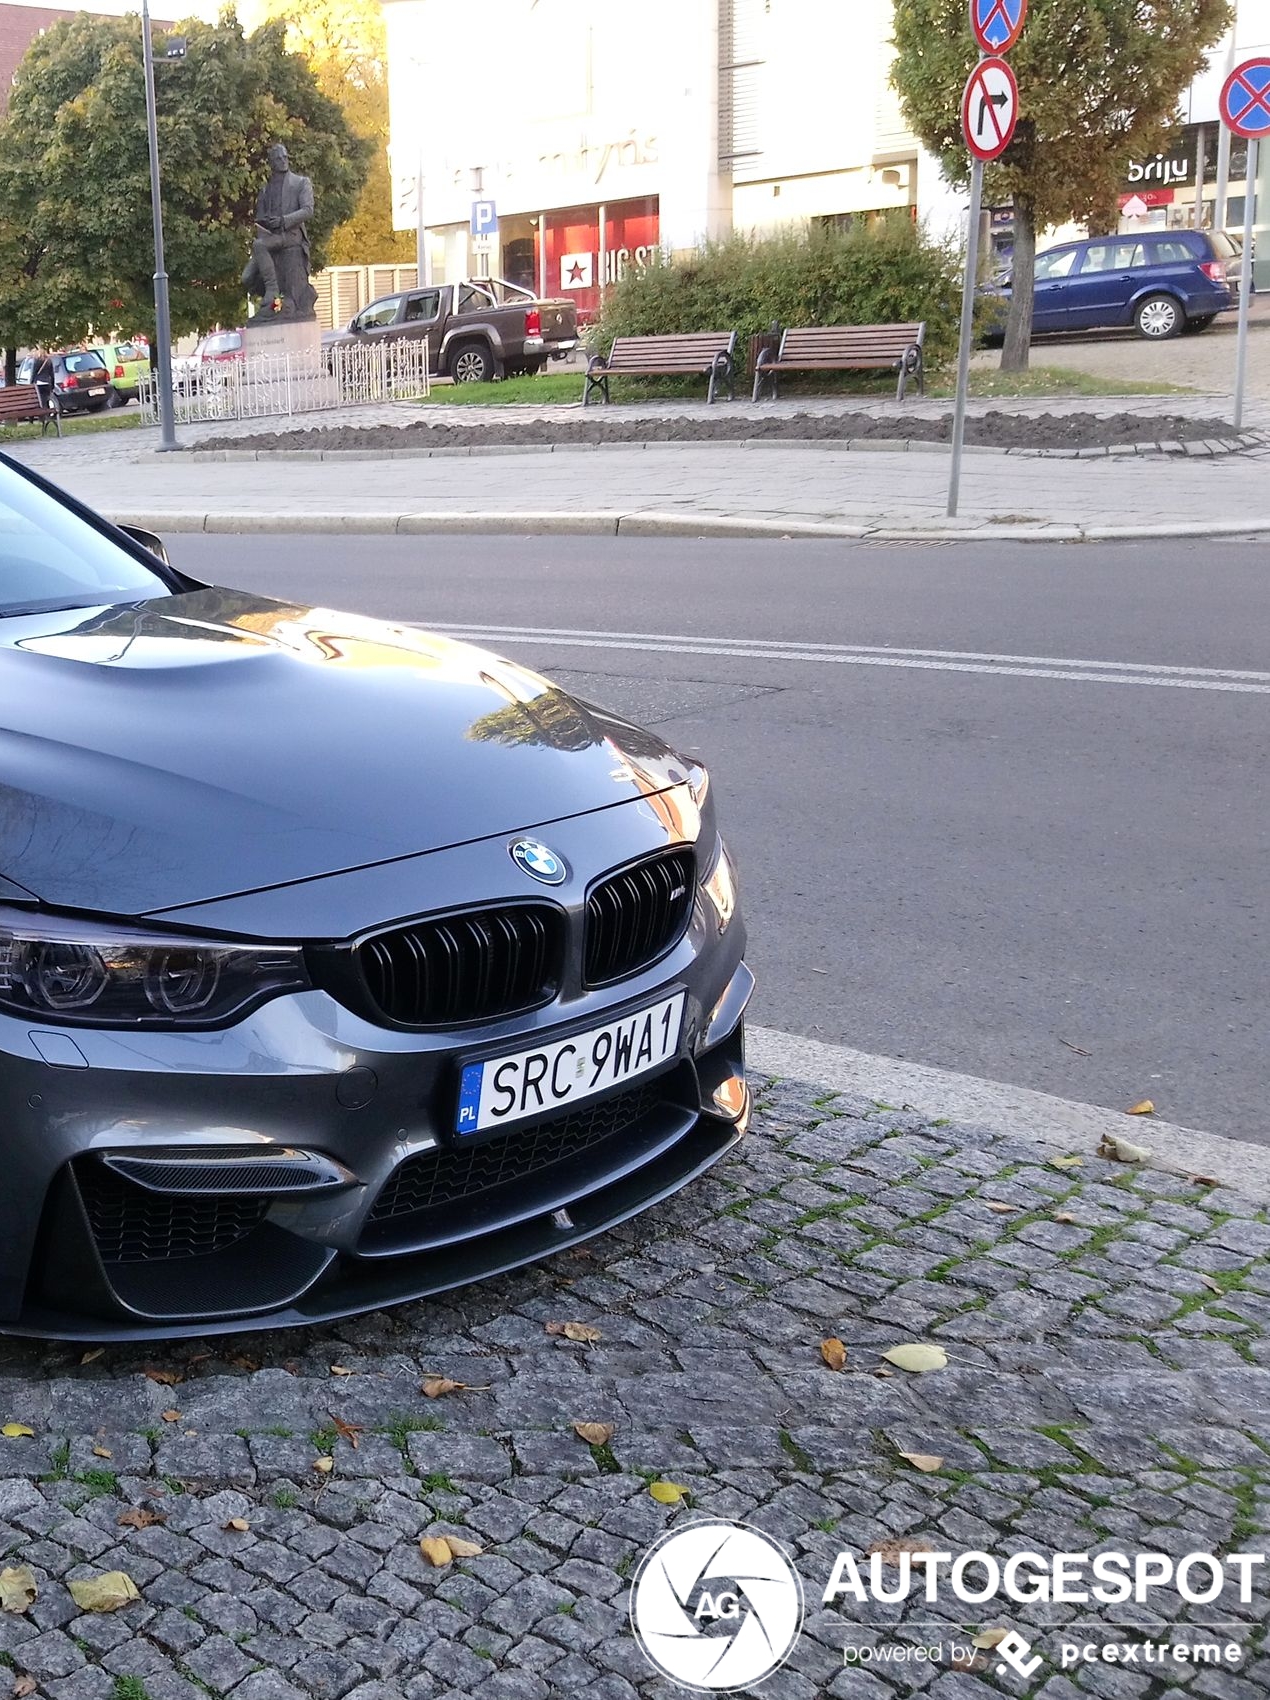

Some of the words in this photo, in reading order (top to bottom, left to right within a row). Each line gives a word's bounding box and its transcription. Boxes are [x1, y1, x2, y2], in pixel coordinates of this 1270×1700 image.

[1128, 153, 1187, 184] briju
[476, 203, 492, 231] P
[598, 248, 629, 288] BIG
[459, 1106, 476, 1123] PL
[490, 1043, 577, 1117] SRC
[589, 1003, 673, 1088] 9WA1
